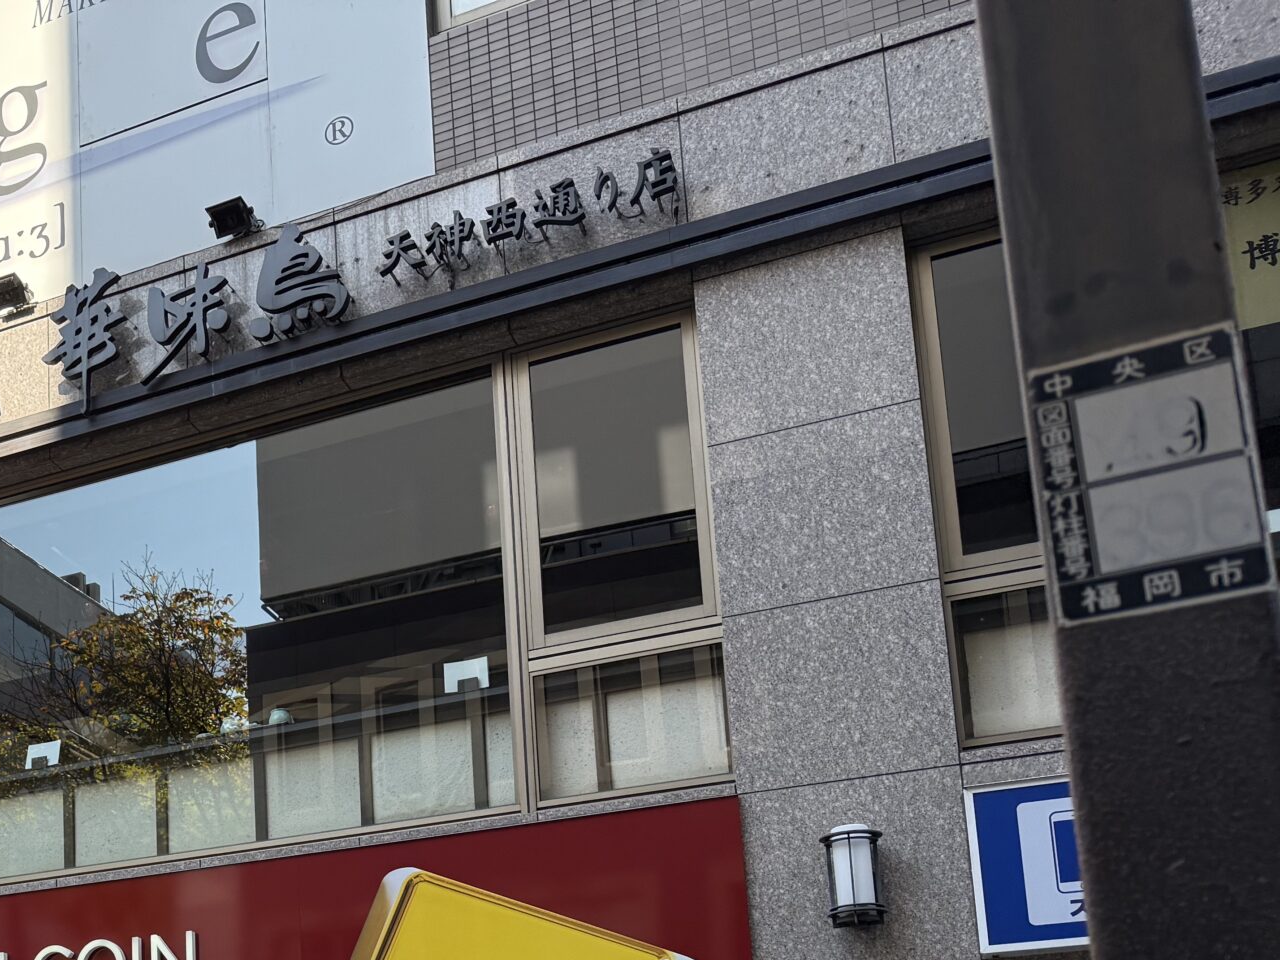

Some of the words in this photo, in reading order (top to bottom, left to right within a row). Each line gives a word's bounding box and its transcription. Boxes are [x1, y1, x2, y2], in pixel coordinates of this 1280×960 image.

[42, 223, 351, 416] 華味鳥
[376, 148, 678, 278] 天神西通り店
[1043, 336, 1216, 398] 中央区
[1080, 557, 1246, 614] 福岡市
